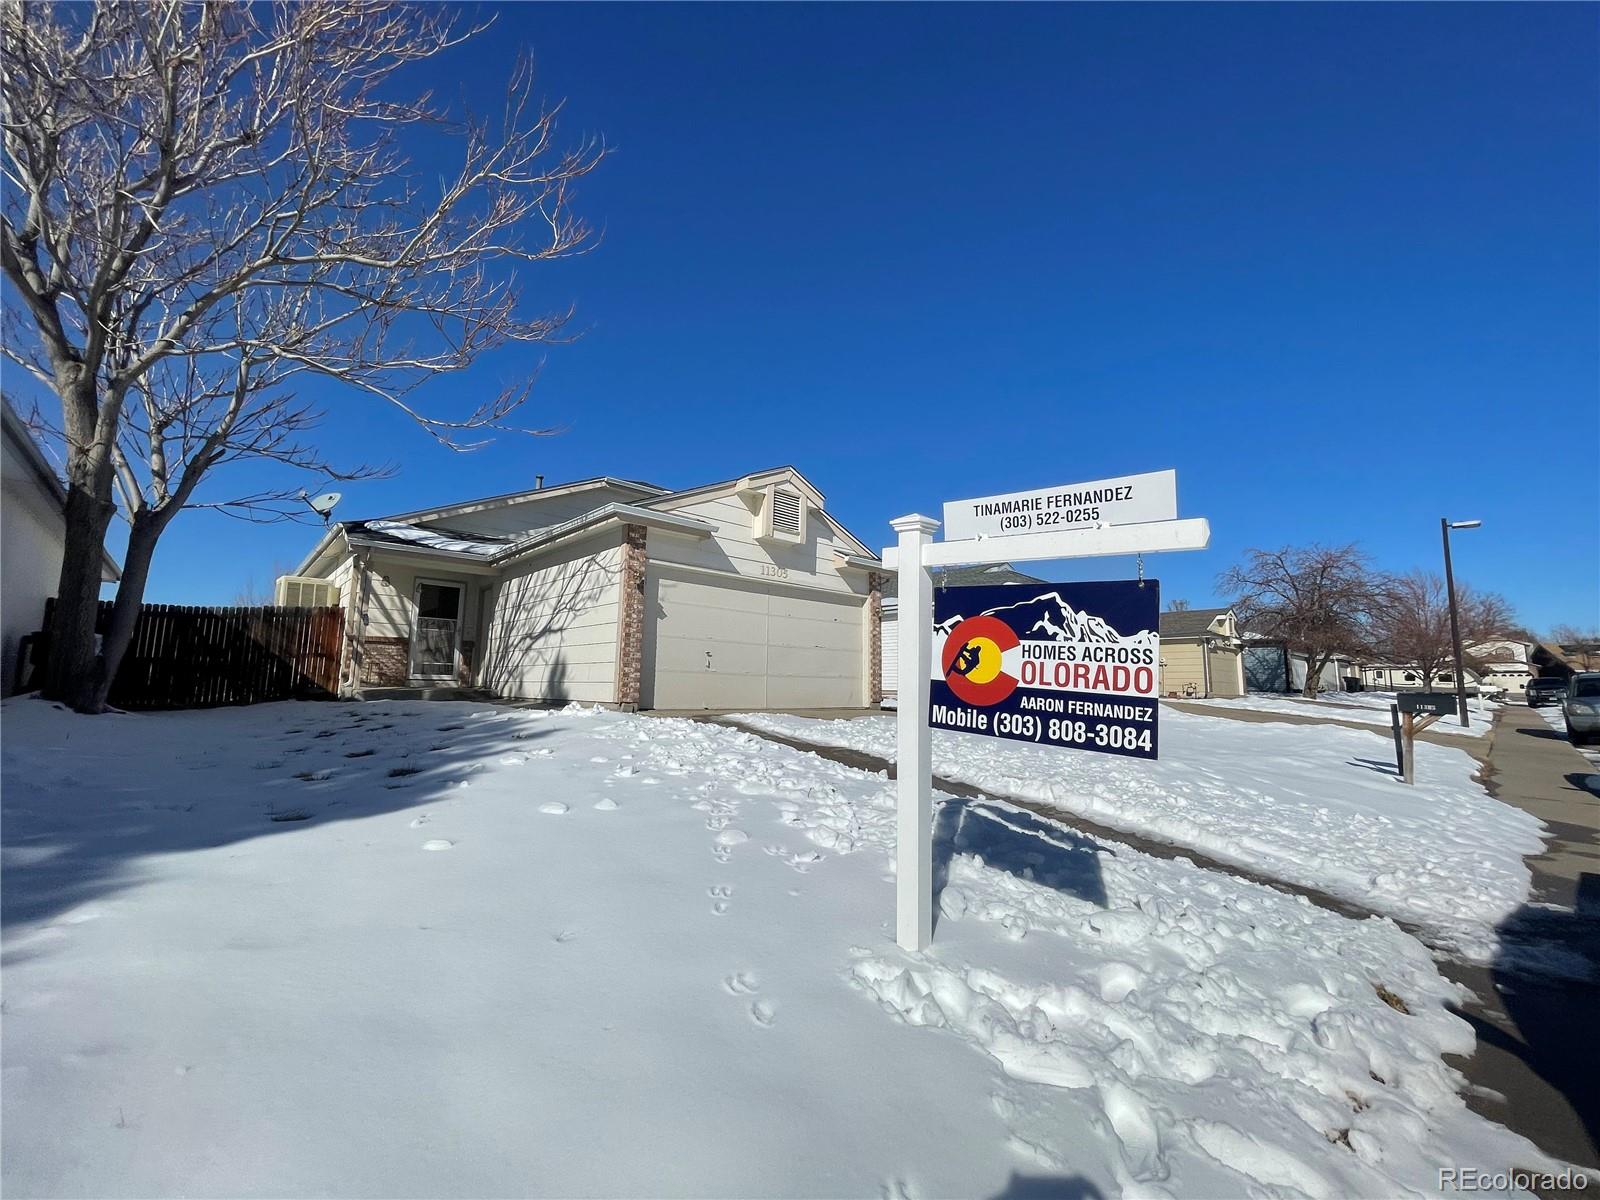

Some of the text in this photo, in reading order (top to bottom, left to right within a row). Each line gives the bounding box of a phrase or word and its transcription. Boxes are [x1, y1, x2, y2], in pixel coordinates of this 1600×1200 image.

[973, 485, 1133, 517] TINAMARIE FERNANDEZ
[1000, 507, 1100, 532] (303) 522-0255
[760, 564, 788, 579] 11305
[1021, 644, 1154, 665] HOMES ACROSS
[1020, 696, 1153, 722] AARON FERNANDEZ
[932, 705, 1153, 752] Mobile (303) 808-3084
